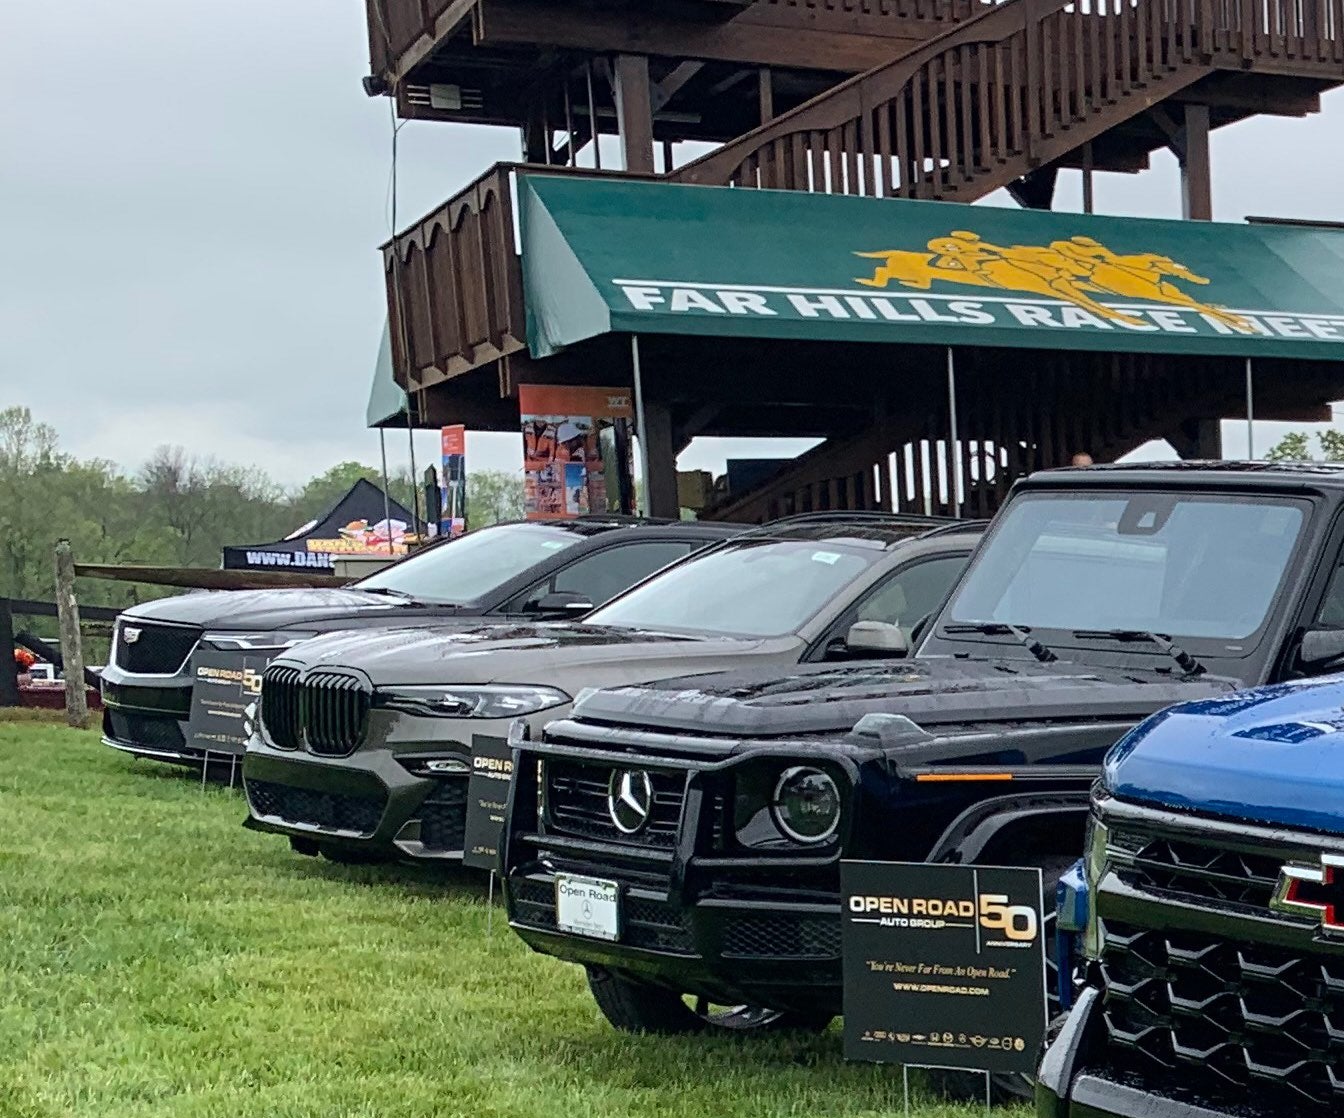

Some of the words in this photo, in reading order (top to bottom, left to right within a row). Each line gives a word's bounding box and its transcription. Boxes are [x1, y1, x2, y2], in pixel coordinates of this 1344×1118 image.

[621, 285, 778, 315] FAR
[785, 294, 996, 325] HILLS
[1003, 303, 1197, 335] RACE
[473, 757, 503, 771] OPEN
[560, 884, 586, 898] Open
[589, 889, 617, 902] Road
[849, 896, 909, 914] OPEN
[912, 898, 975, 917] ROAD
[880, 917, 908, 928] AUTO
[909, 919, 946, 929] GROUP
[978, 894, 1037, 941] 50
